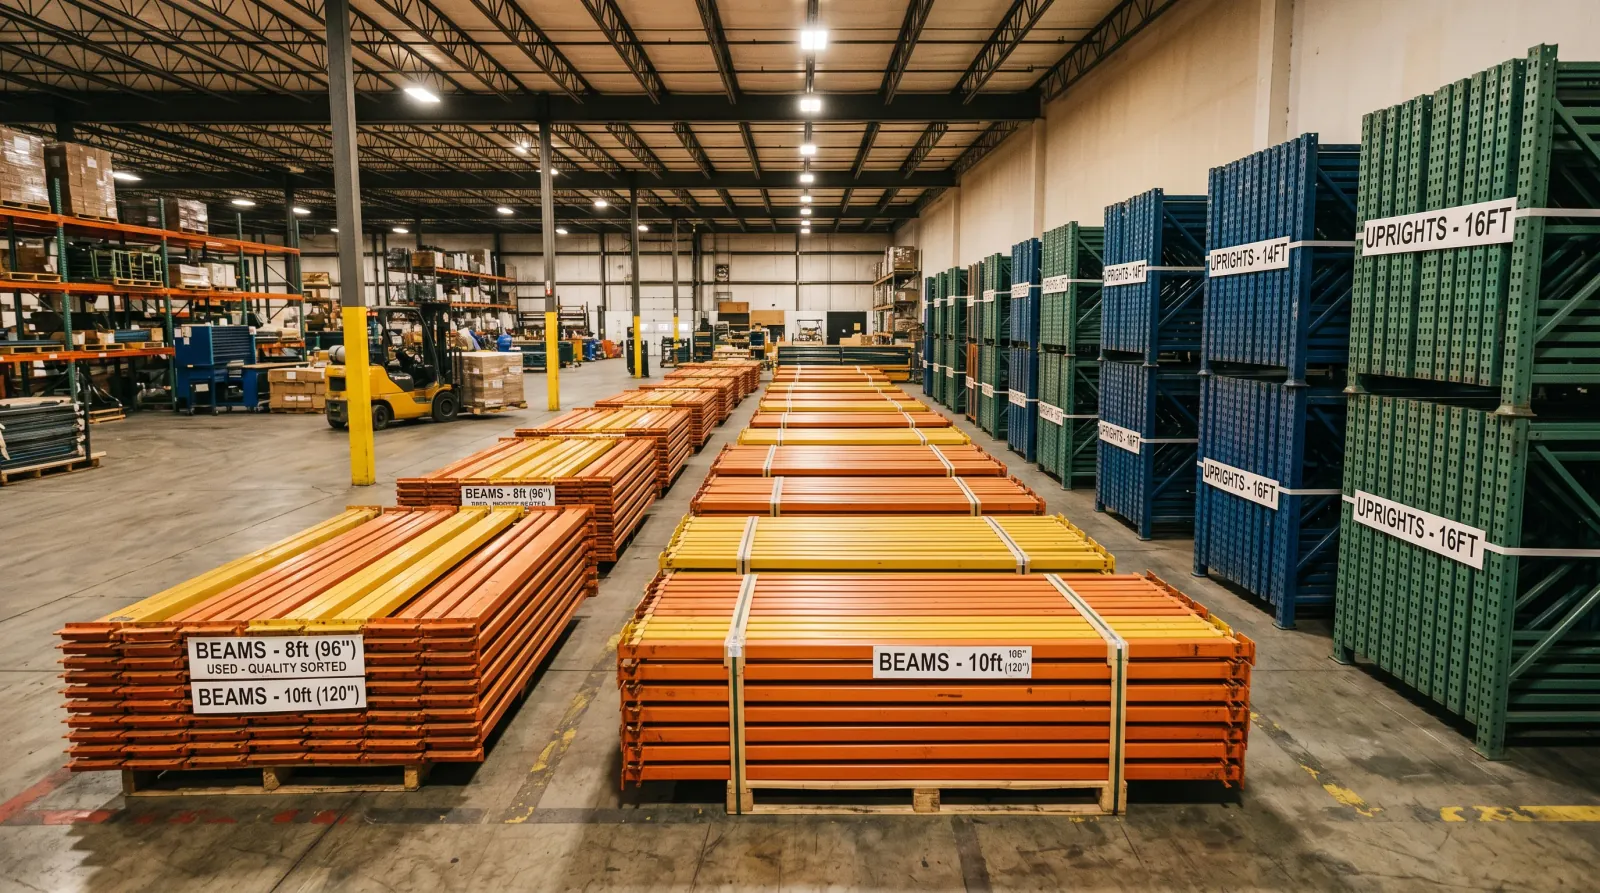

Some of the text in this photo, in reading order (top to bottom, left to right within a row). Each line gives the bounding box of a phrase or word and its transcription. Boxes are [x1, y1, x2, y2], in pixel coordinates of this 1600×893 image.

[1365, 216, 1447, 248] UPRIGHTS
[1465, 206, 1512, 237] 16FT
[1210, 248, 1254, 271] UPRIGHTS
[1262, 242, 1287, 264] 14FT
[1204, 462, 1245, 491] UPRIGHTS
[1253, 480, 1276, 502] 16FT
[465, 488, 504, 499] BEAMS
[513, 488, 527, 499] 8ft
[529, 488, 552, 500] (96")
[1357, 496, 1425, 539] UPRIGHTS
[1439, 525, 1479, 558] 16FT
[196, 641, 267, 660] BEAMS
[285, 641, 309, 658] 8ft
[315, 640, 356, 660] (96")
[207, 664, 238, 674] USED
[248, 662, 297, 674] QUALITY
[300, 661, 347, 672] SORTED
[879, 652, 949, 672] BEAMS
[969, 653, 1003, 672] 10ft
[1004, 662, 1030, 675] (120")
[199, 687, 267, 706] BEAMS
[284, 687, 312, 703] 10ft
[316, 685, 360, 706] (120")
